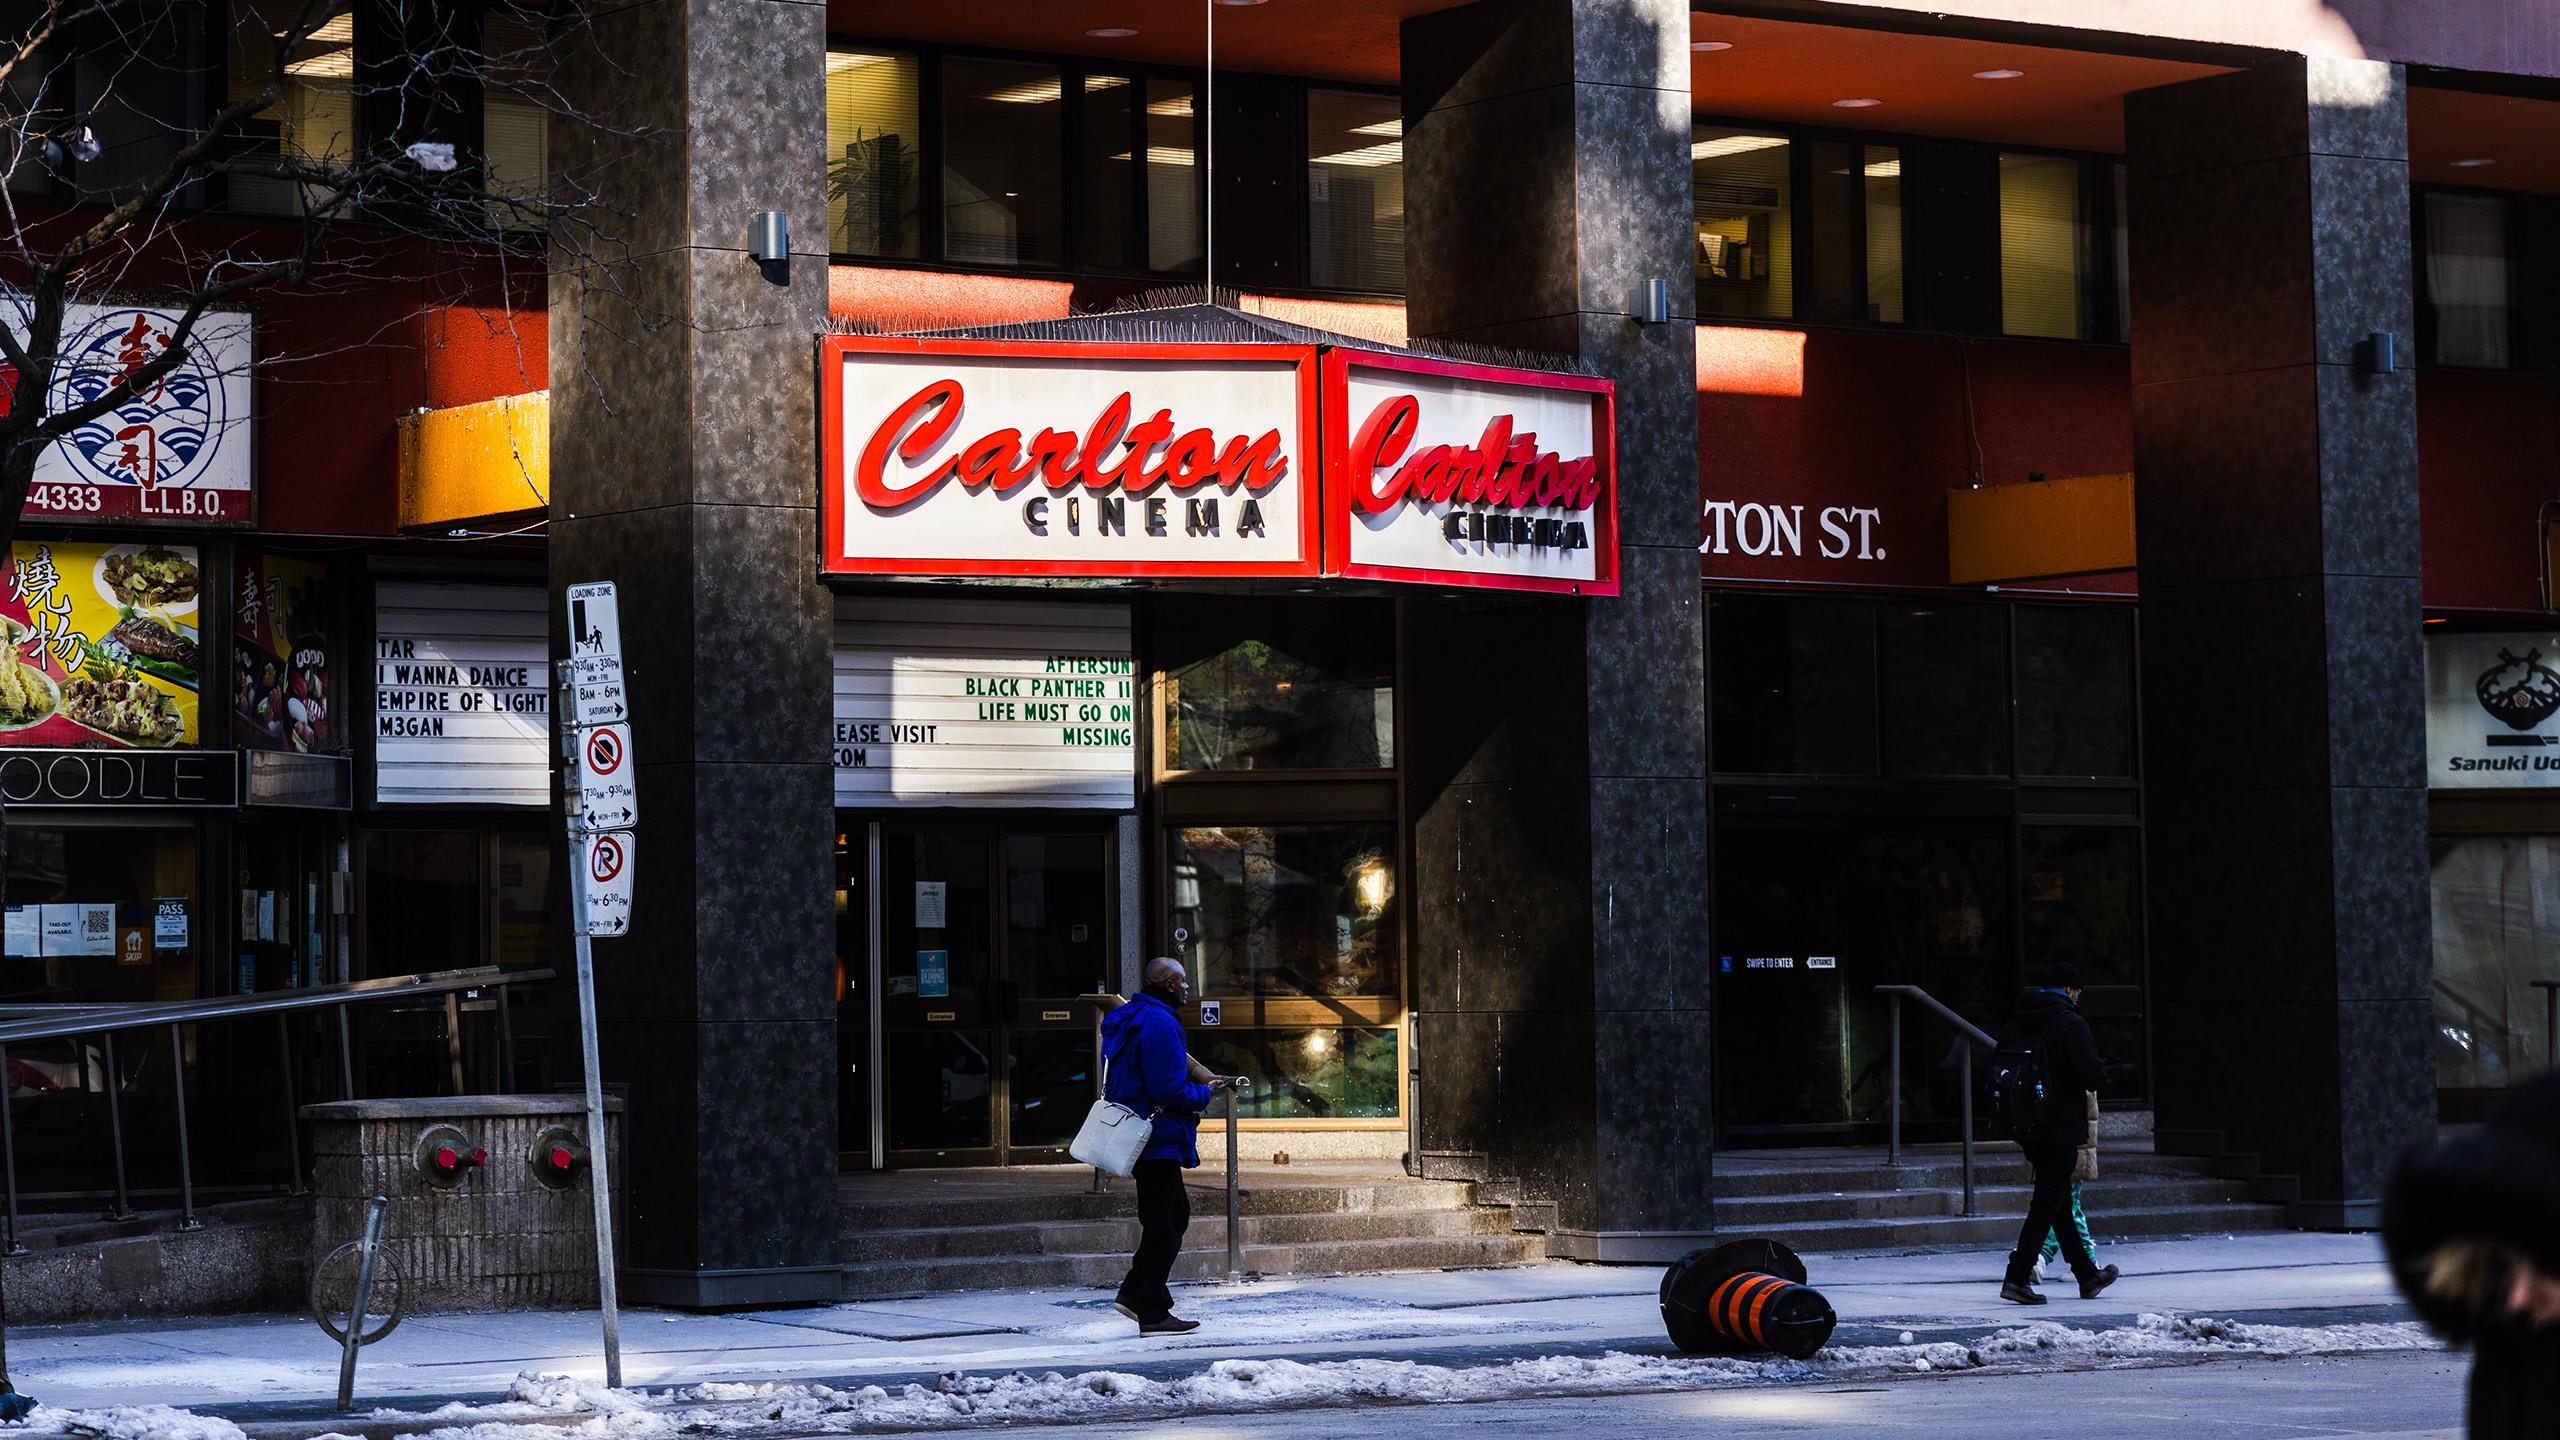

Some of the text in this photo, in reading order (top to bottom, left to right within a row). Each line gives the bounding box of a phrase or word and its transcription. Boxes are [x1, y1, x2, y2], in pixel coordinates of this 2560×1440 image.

[856, 378, 1289, 509] Carlton
[1350, 394, 1601, 514] Carlton
[140, 488, 226, 516] L.L.B.O.
[1023, 496, 1266, 535] CINEMA
[1443, 511, 1590, 549] CINEMA
[1818, 505, 1886, 561] ST.
[571, 586, 612, 599] LOADING ZONE
[8, 544, 88, 673] 燒物
[378, 639, 415, 659] TAR
[1046, 656, 1130, 675] AFTERSUN
[378, 665, 528, 687] I WANNA DANCE
[587, 675, 597, 683] MON
[601, 673, 609, 681] FRI
[580, 687, 596, 701] 8AM
[604, 685, 621, 699] 6PM
[966, 678, 1131, 698] BLACK PANTHER II
[378, 691, 548, 712] EMPIRE OF LIGHT
[588, 704, 614, 716] SATURDAY
[978, 702, 1131, 723] LIFE MUST GO ON
[379, 717, 443, 737] M3GAN
[833, 724, 937, 744] EASE VISIT
[1062, 727, 1131, 747] MISSING
[2448, 754, 2529, 771] Sanuki
[158, 904, 184, 915] PASS
[124, 952, 143, 962] SKIP
[1746, 958, 1794, 968] SWIPE TO ENTER
[1810, 958, 1833, 966] ENTRANCE
